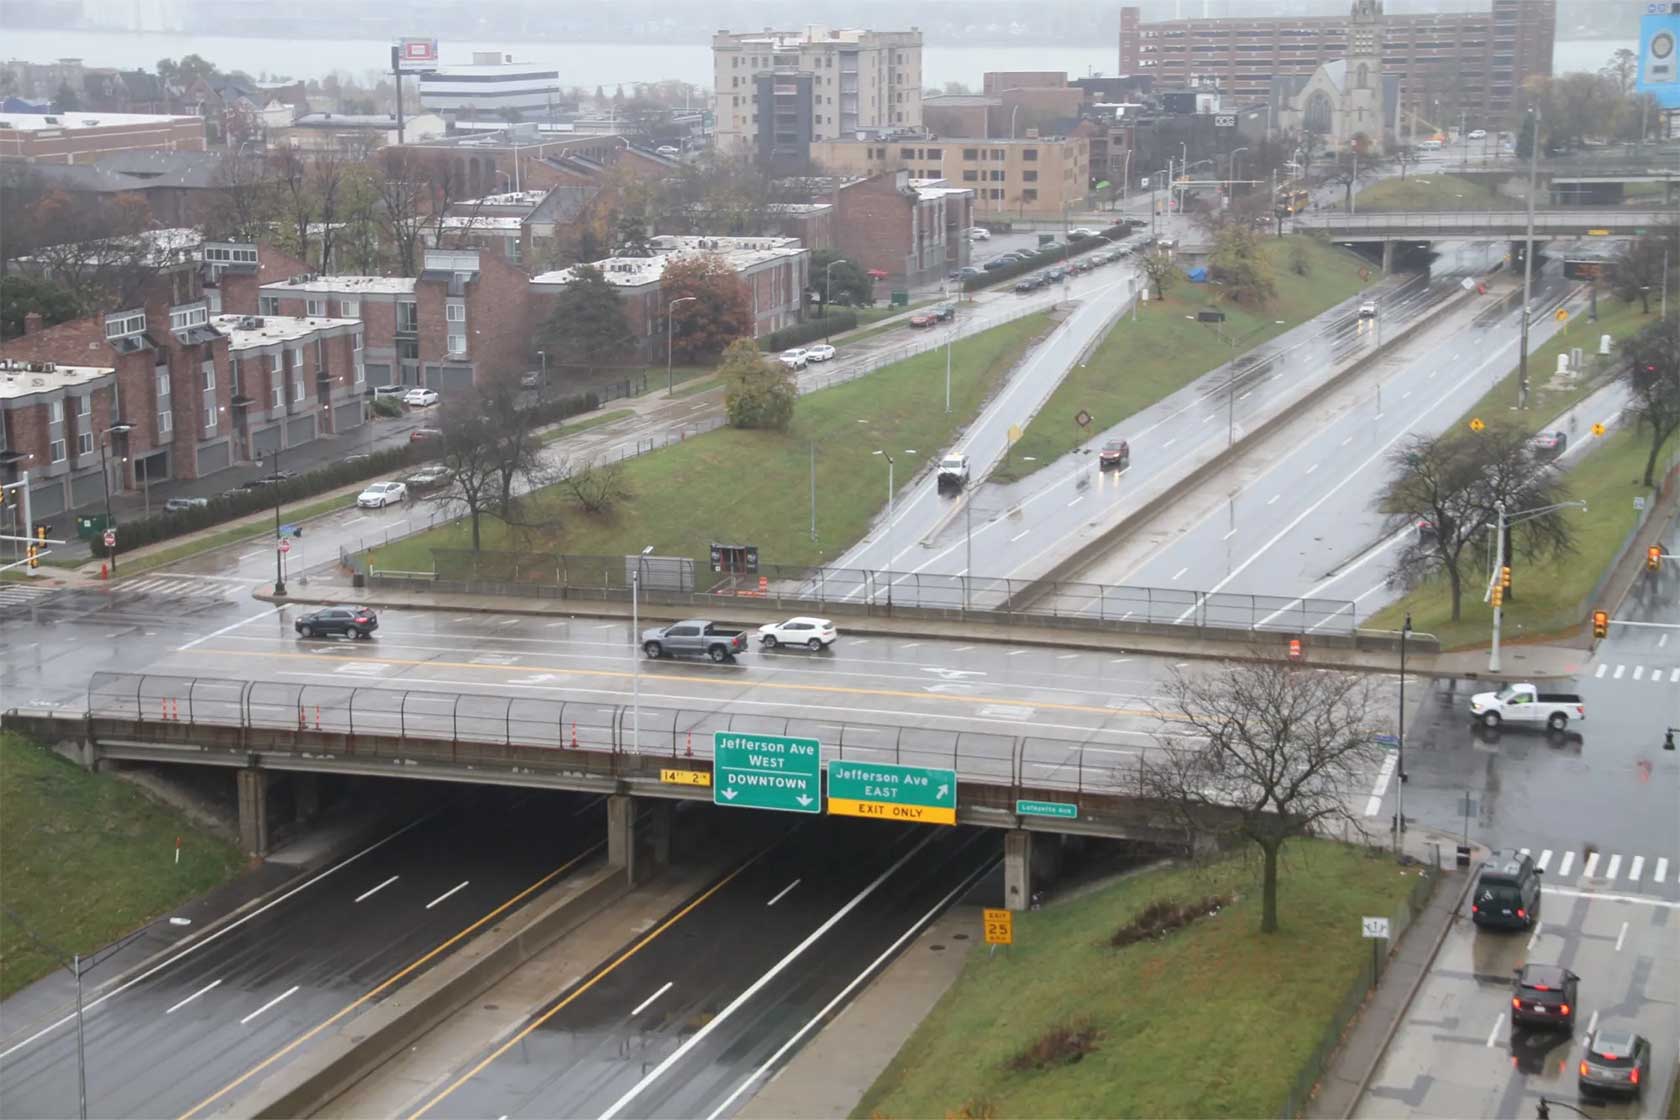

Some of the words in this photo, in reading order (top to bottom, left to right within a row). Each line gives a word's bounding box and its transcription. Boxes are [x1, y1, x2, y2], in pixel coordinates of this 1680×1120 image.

[720, 738, 784, 752] Jefferson
[790, 744, 814, 755] Ave
[749, 754, 784, 768] WEST
[728, 774, 806, 790] DOWNTOWN
[836, 768, 899, 783] Jefferson
[904, 774, 928, 786] Ave
[865, 786, 898, 798] EAST
[858, 804, 884, 814] EXIT
[893, 807, 923, 818] ONLY
[988, 924, 1008, 935] 25
